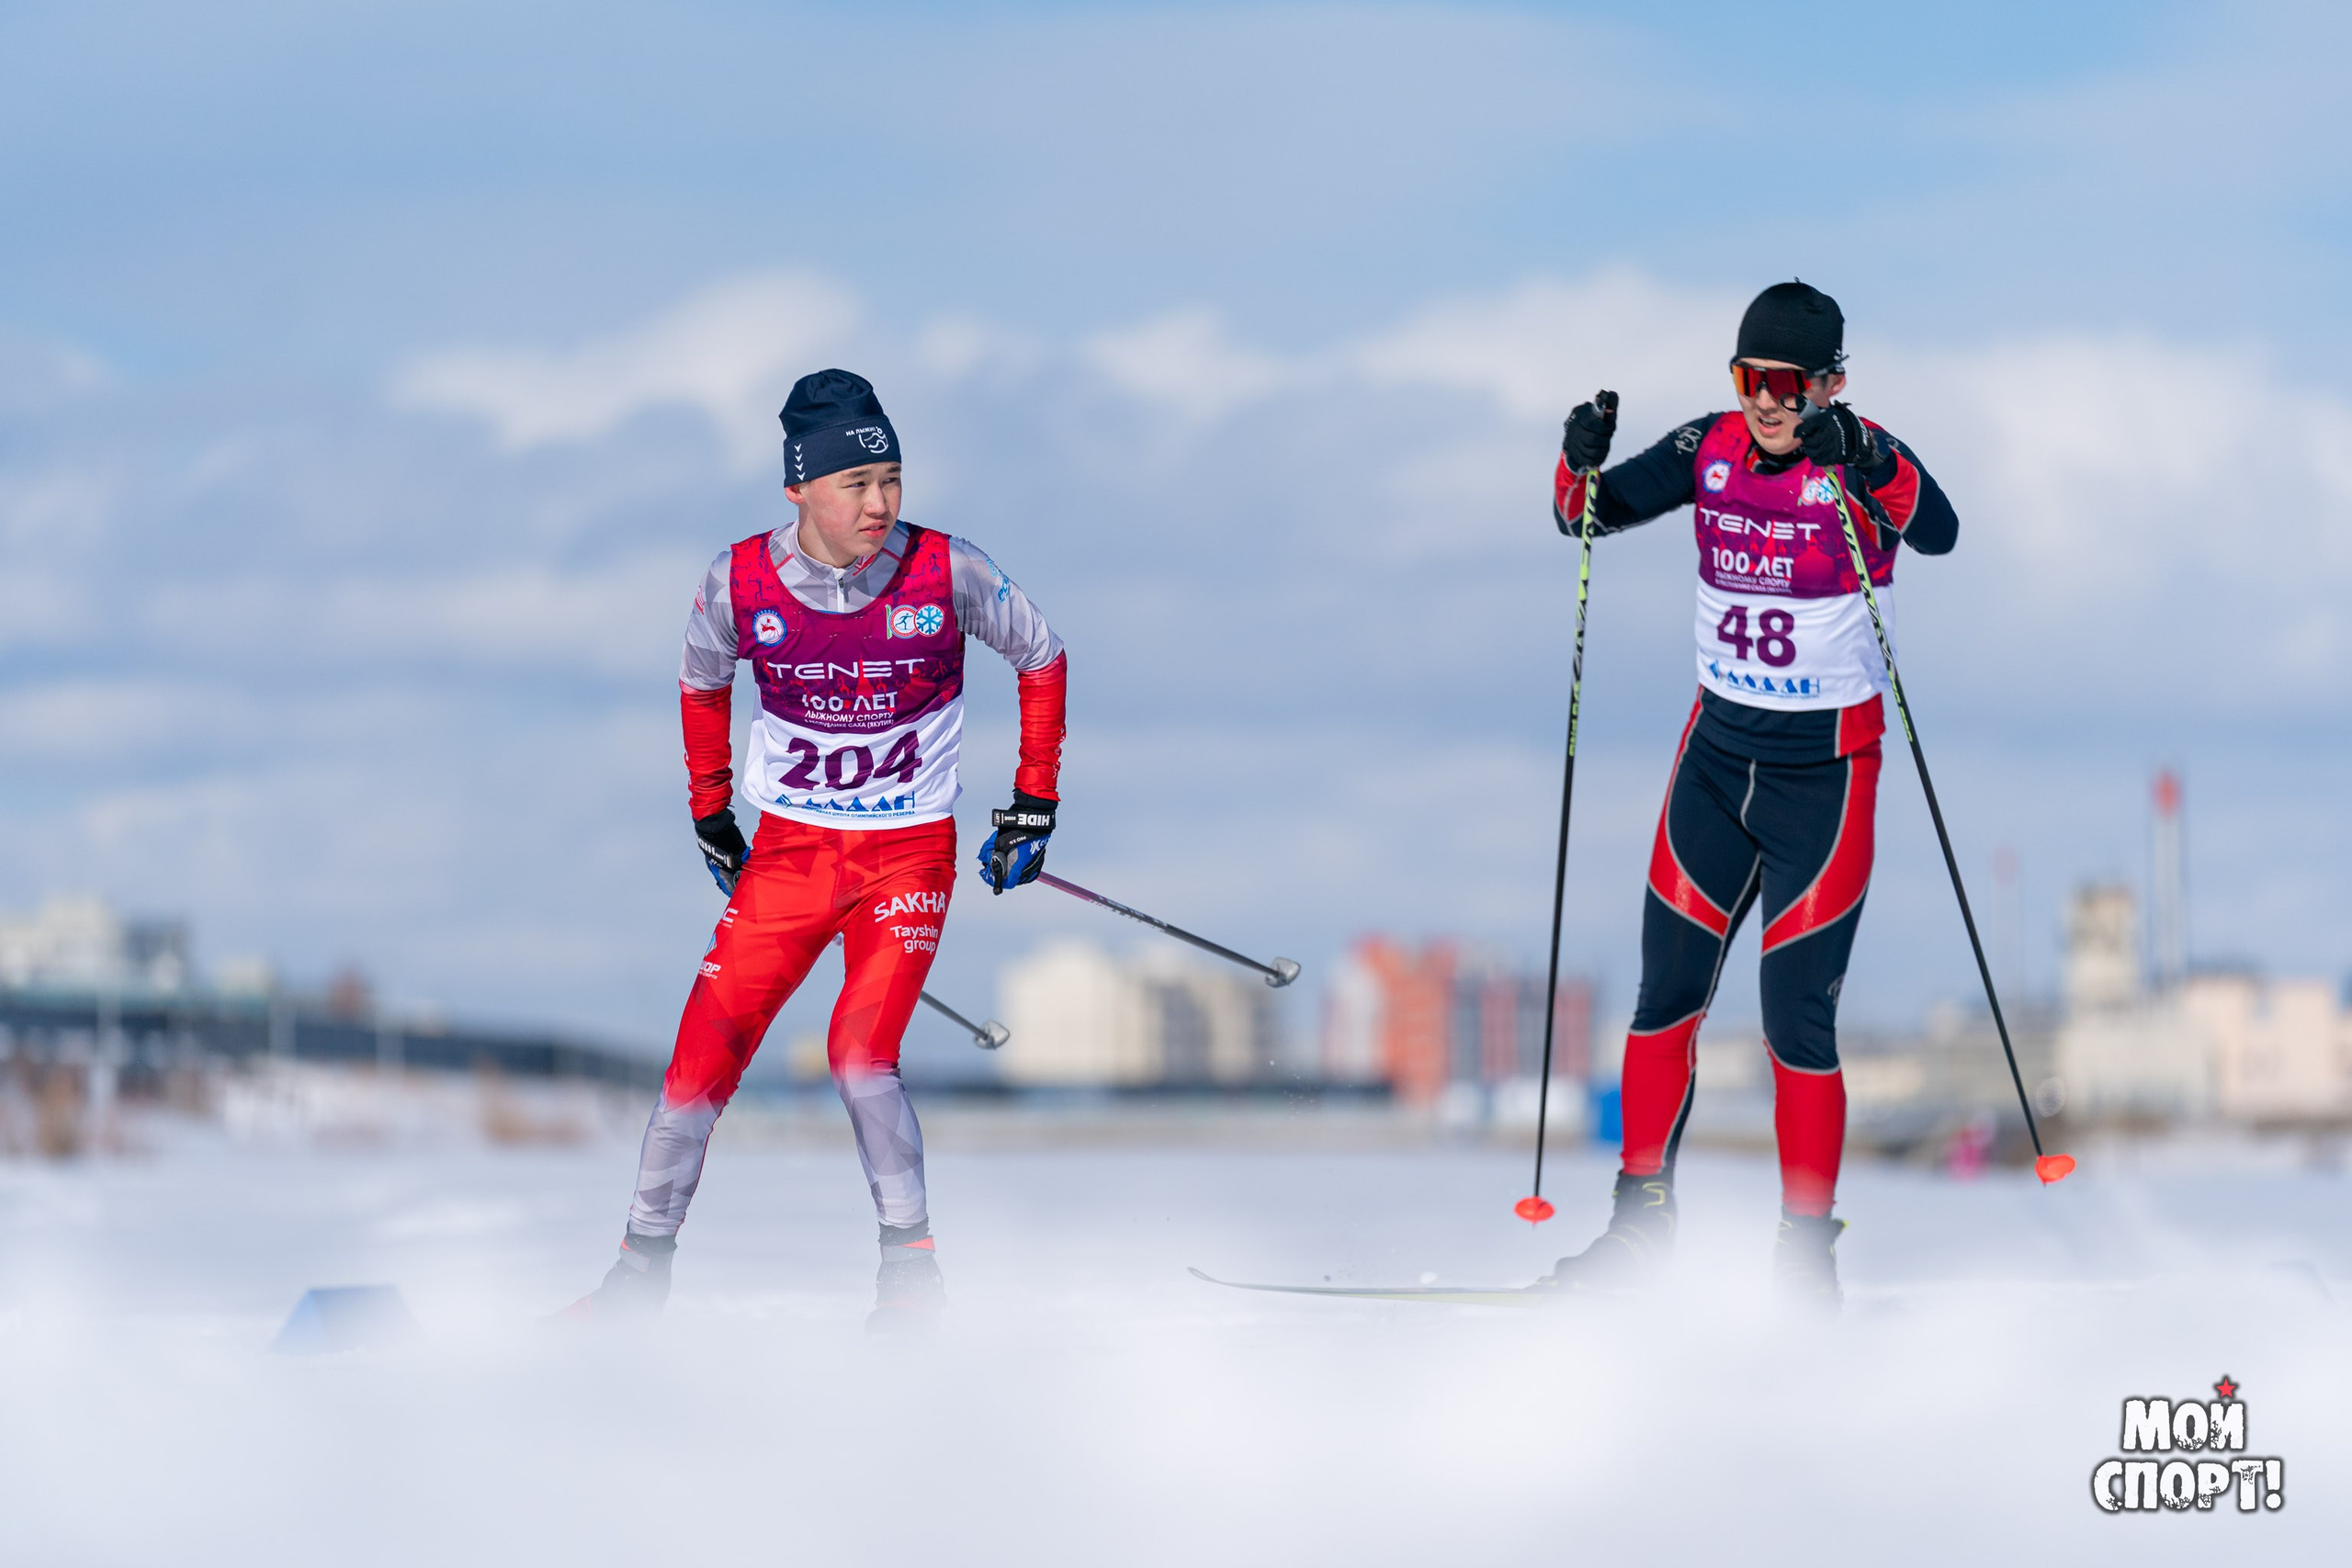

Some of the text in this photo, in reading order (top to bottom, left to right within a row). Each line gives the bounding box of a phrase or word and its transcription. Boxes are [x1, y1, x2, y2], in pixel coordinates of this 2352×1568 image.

[1699, 507, 1821, 541] TENET
[1712, 547, 1794, 579] 100 ЛЕТ
[1716, 604, 1796, 668] 48
[766, 658, 925, 680] TENET
[801, 691, 899, 712] 100 ЛЕТ
[805, 710, 895, 723] ЛЫЖНОМУ СПОРТУ
[778, 729, 922, 791] 204
[1017, 813, 1050, 827] HIDE
[874, 891, 946, 923] SAKHA
[889, 924, 939, 940] Tayshin
[903, 940, 936, 955] group
